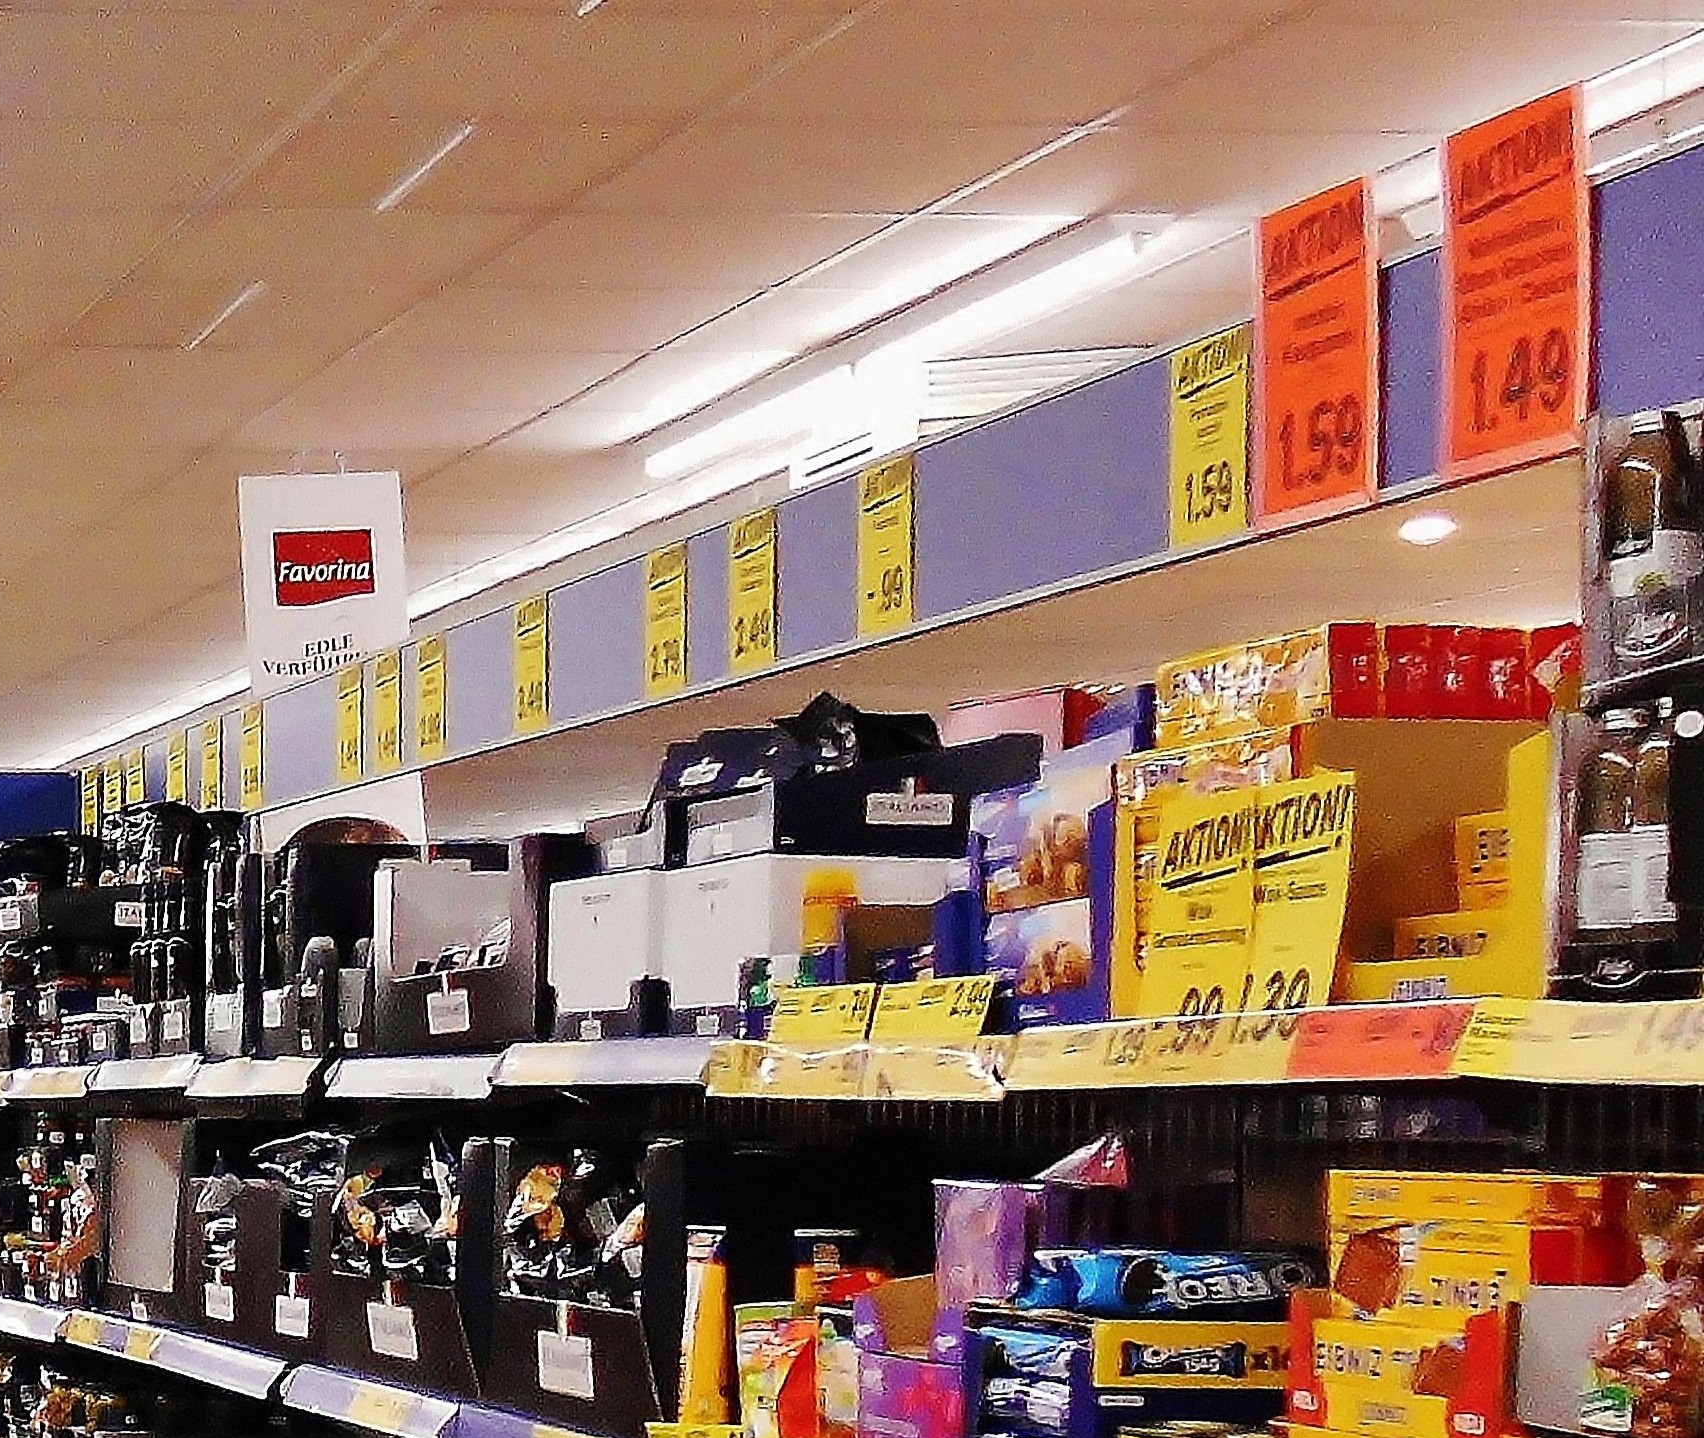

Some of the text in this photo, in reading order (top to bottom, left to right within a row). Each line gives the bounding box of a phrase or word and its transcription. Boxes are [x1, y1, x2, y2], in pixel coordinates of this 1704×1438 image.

[1472, 326, 1570, 433] 1.49
[278, 557, 372, 584] Favorina
[303, 633, 354, 658] EDLE
